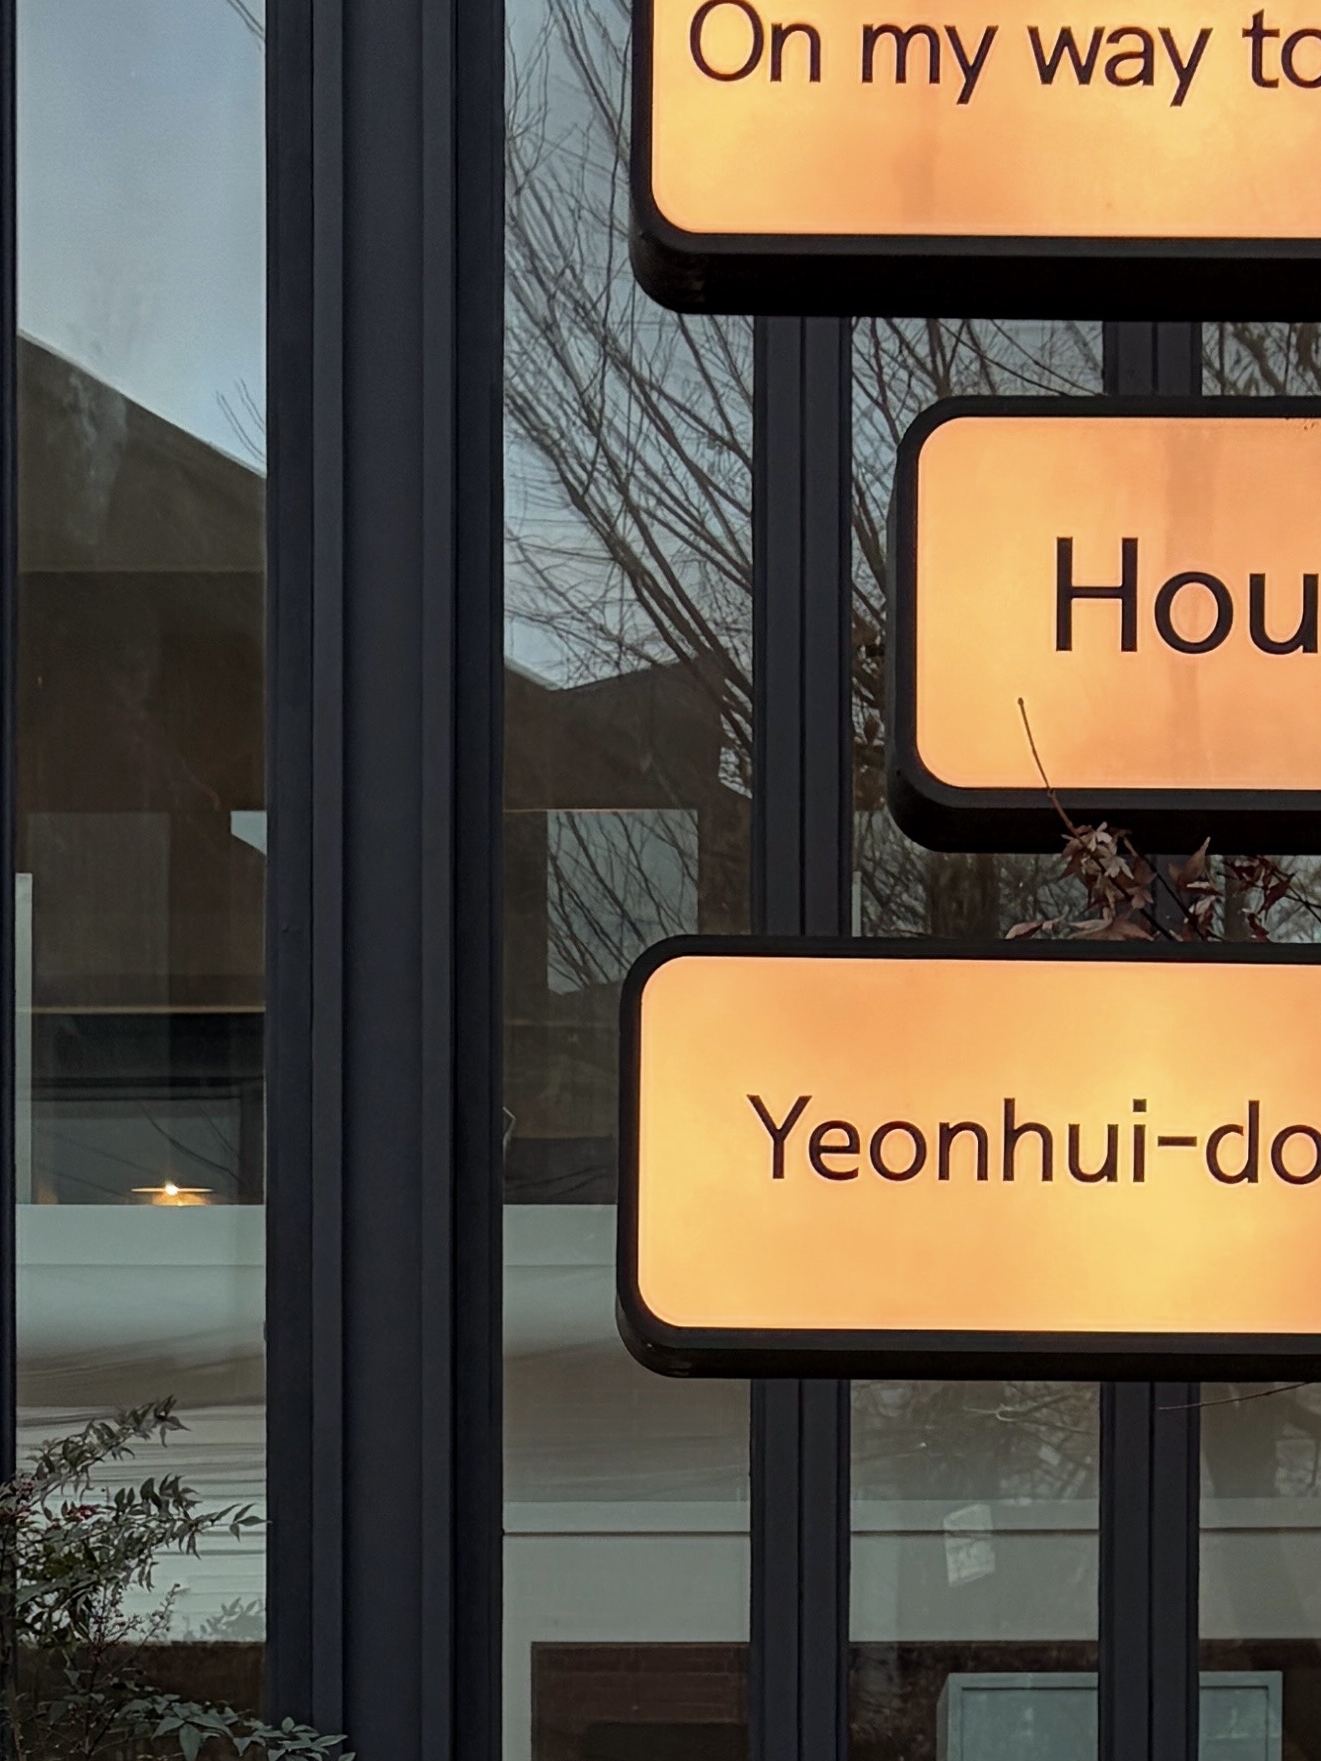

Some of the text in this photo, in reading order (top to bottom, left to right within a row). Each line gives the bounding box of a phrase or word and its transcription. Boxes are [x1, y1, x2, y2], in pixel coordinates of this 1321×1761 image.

[689, 0, 821, 83] On
[861, 23, 999, 105] my
[1027, 25, 1213, 107] way
